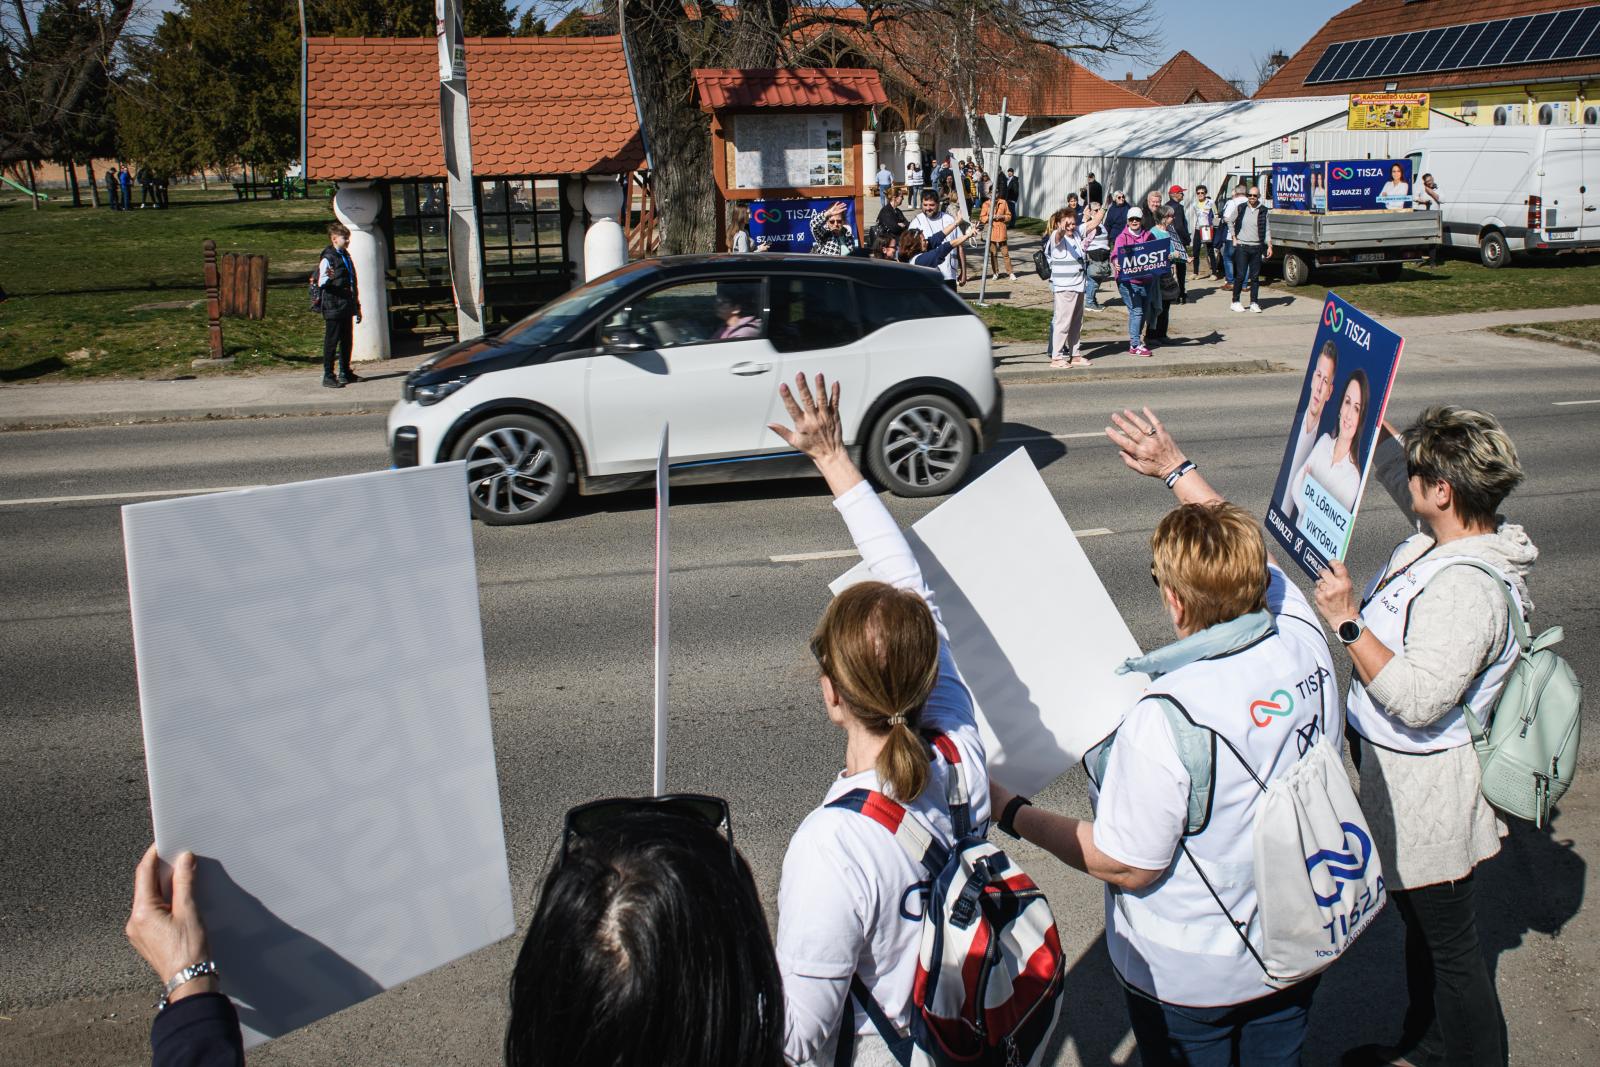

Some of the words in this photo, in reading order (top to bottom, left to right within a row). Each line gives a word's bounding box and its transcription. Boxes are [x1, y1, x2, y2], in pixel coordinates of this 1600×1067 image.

[1356, 167, 1384, 177] TISZA
[1276, 174, 1305, 193] MOST
[1331, 188, 1362, 196] SZAVAZZ!
[785, 208, 818, 220] TISZA
[756, 233, 794, 243] SZAVAZZ!
[1122, 249, 1167, 269] MOST
[1123, 266, 1143, 275] VAGY
[1345, 318, 1371, 351] TISZA
[1304, 484, 1315, 502] DR.
[1316, 495, 1347, 532] LŐRINCZ
[1268, 508, 1294, 543] SZAVAZZ!
[1306, 516, 1337, 558] VIKTÓRIA
